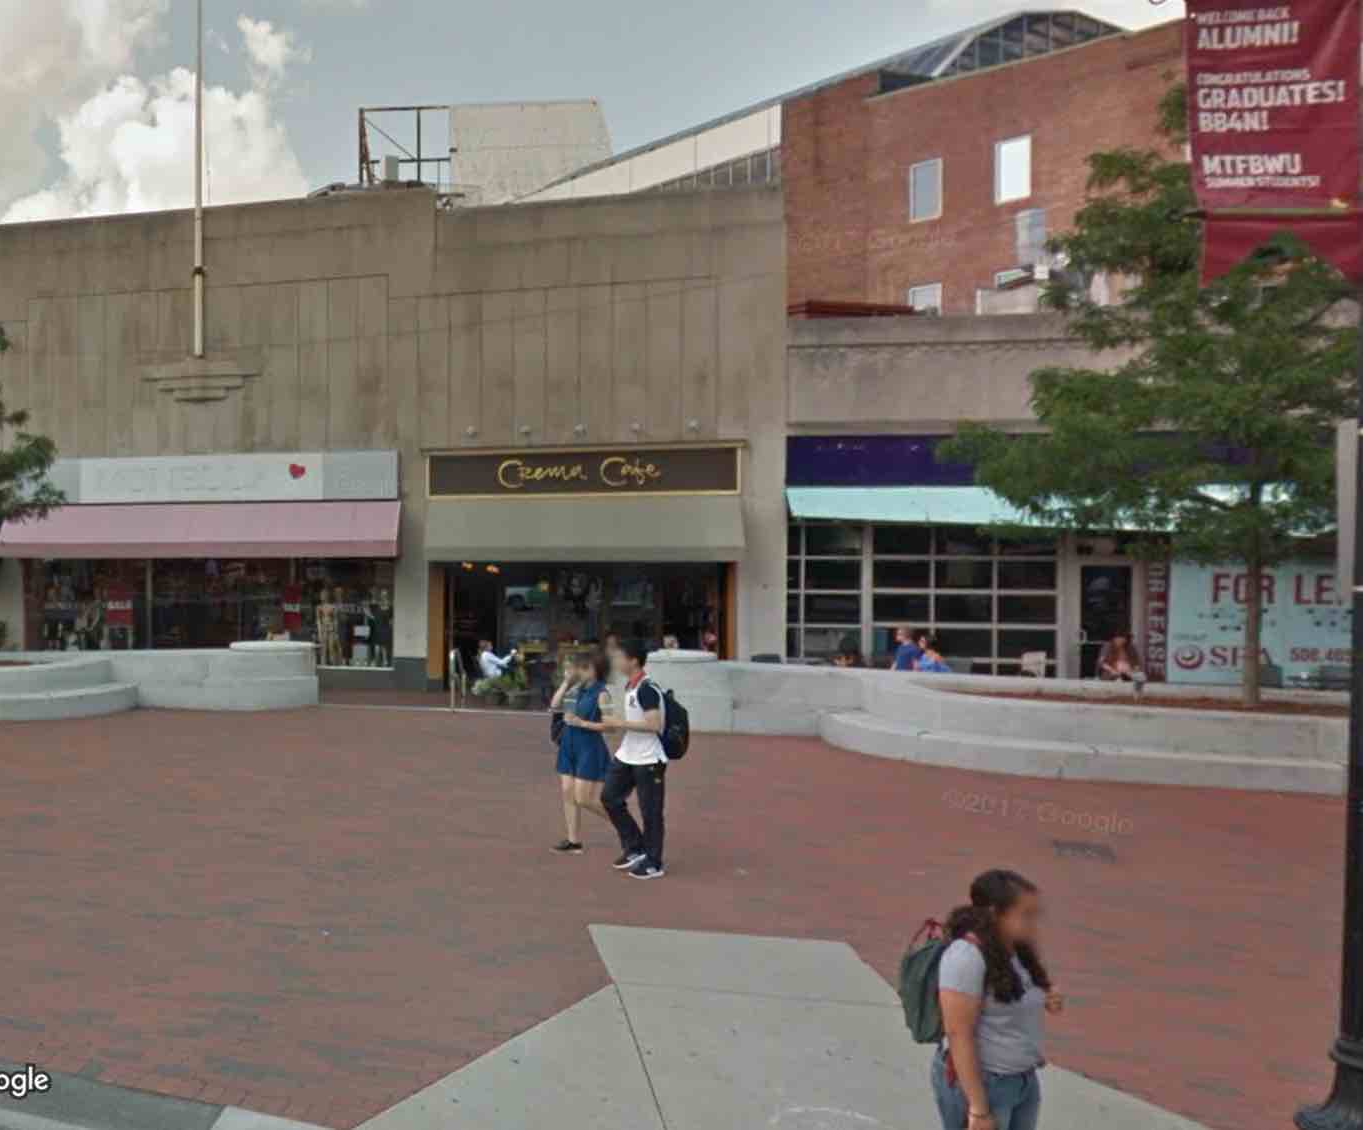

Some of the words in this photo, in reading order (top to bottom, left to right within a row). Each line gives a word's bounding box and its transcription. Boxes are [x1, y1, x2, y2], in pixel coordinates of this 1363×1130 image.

[1197, 10, 1256, 25] WELCOME
[1257, 6, 1291, 20] BACK
[1197, 20, 1300, 49] ALUMNI!
[1196, 68, 1311, 86] CONGRATULATIONS
[1197, 81, 1346, 109] GRADUATES!
[1198, 111, 1269, 133] BB4N!
[1202, 153, 1302, 175] MTFBWU
[497, 459, 587, 489] Crema
[600, 456, 661, 487] Cafe
[1293, 573, 1344, 605] LE
